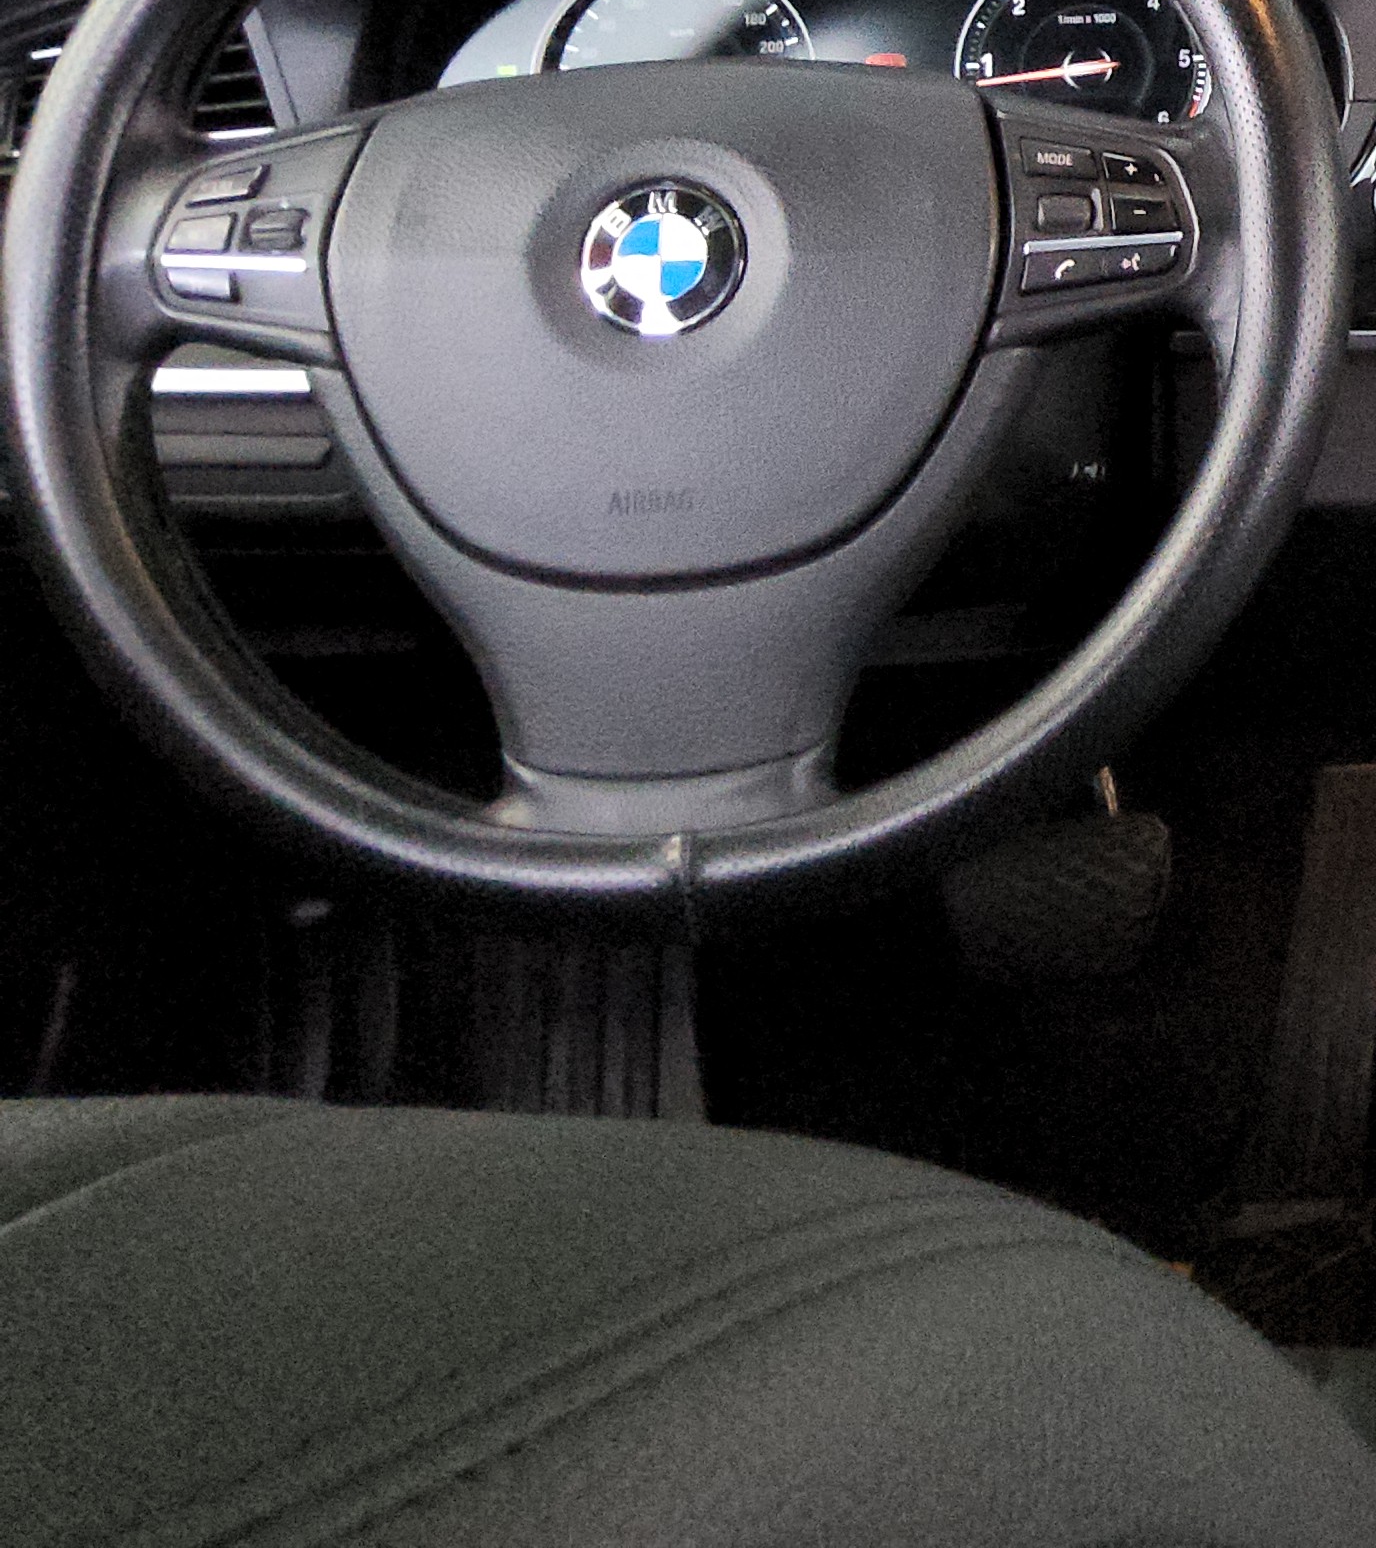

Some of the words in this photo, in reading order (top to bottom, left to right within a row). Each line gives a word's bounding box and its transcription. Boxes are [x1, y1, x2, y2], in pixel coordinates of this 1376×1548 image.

[744, 12, 767, 26] 180
[760, 39, 785, 54] 200
[979, 52, 994, 78] 1
[1177, 48, 1191, 69] 5
[1036, 151, 1074, 167] MODE
[601, 190, 727, 238] BMW
[608, 487, 695, 516] AIRBAG
